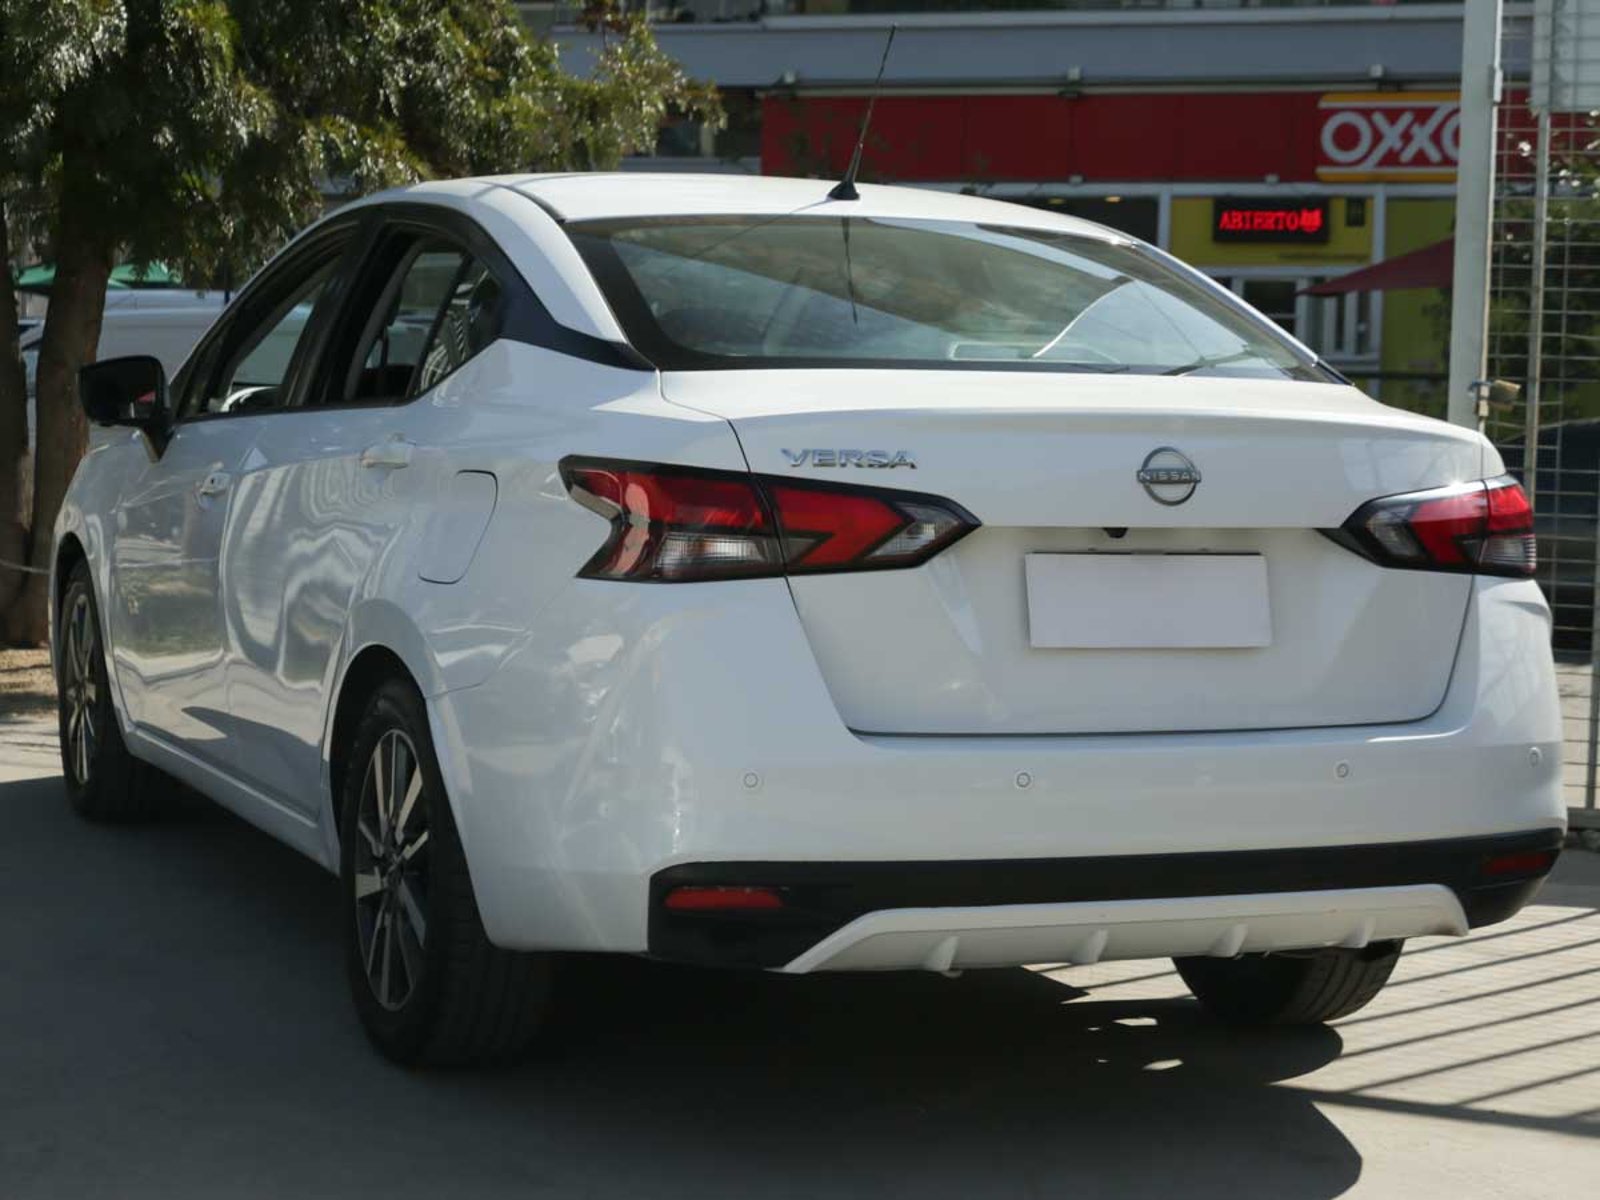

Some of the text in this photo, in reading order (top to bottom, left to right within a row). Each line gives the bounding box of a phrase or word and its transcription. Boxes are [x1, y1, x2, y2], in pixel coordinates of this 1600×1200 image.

[1219, 210, 1298, 230] ABIERTO
[780, 448, 917, 469] VERSA
[1139, 469, 1200, 482] NISSAN
